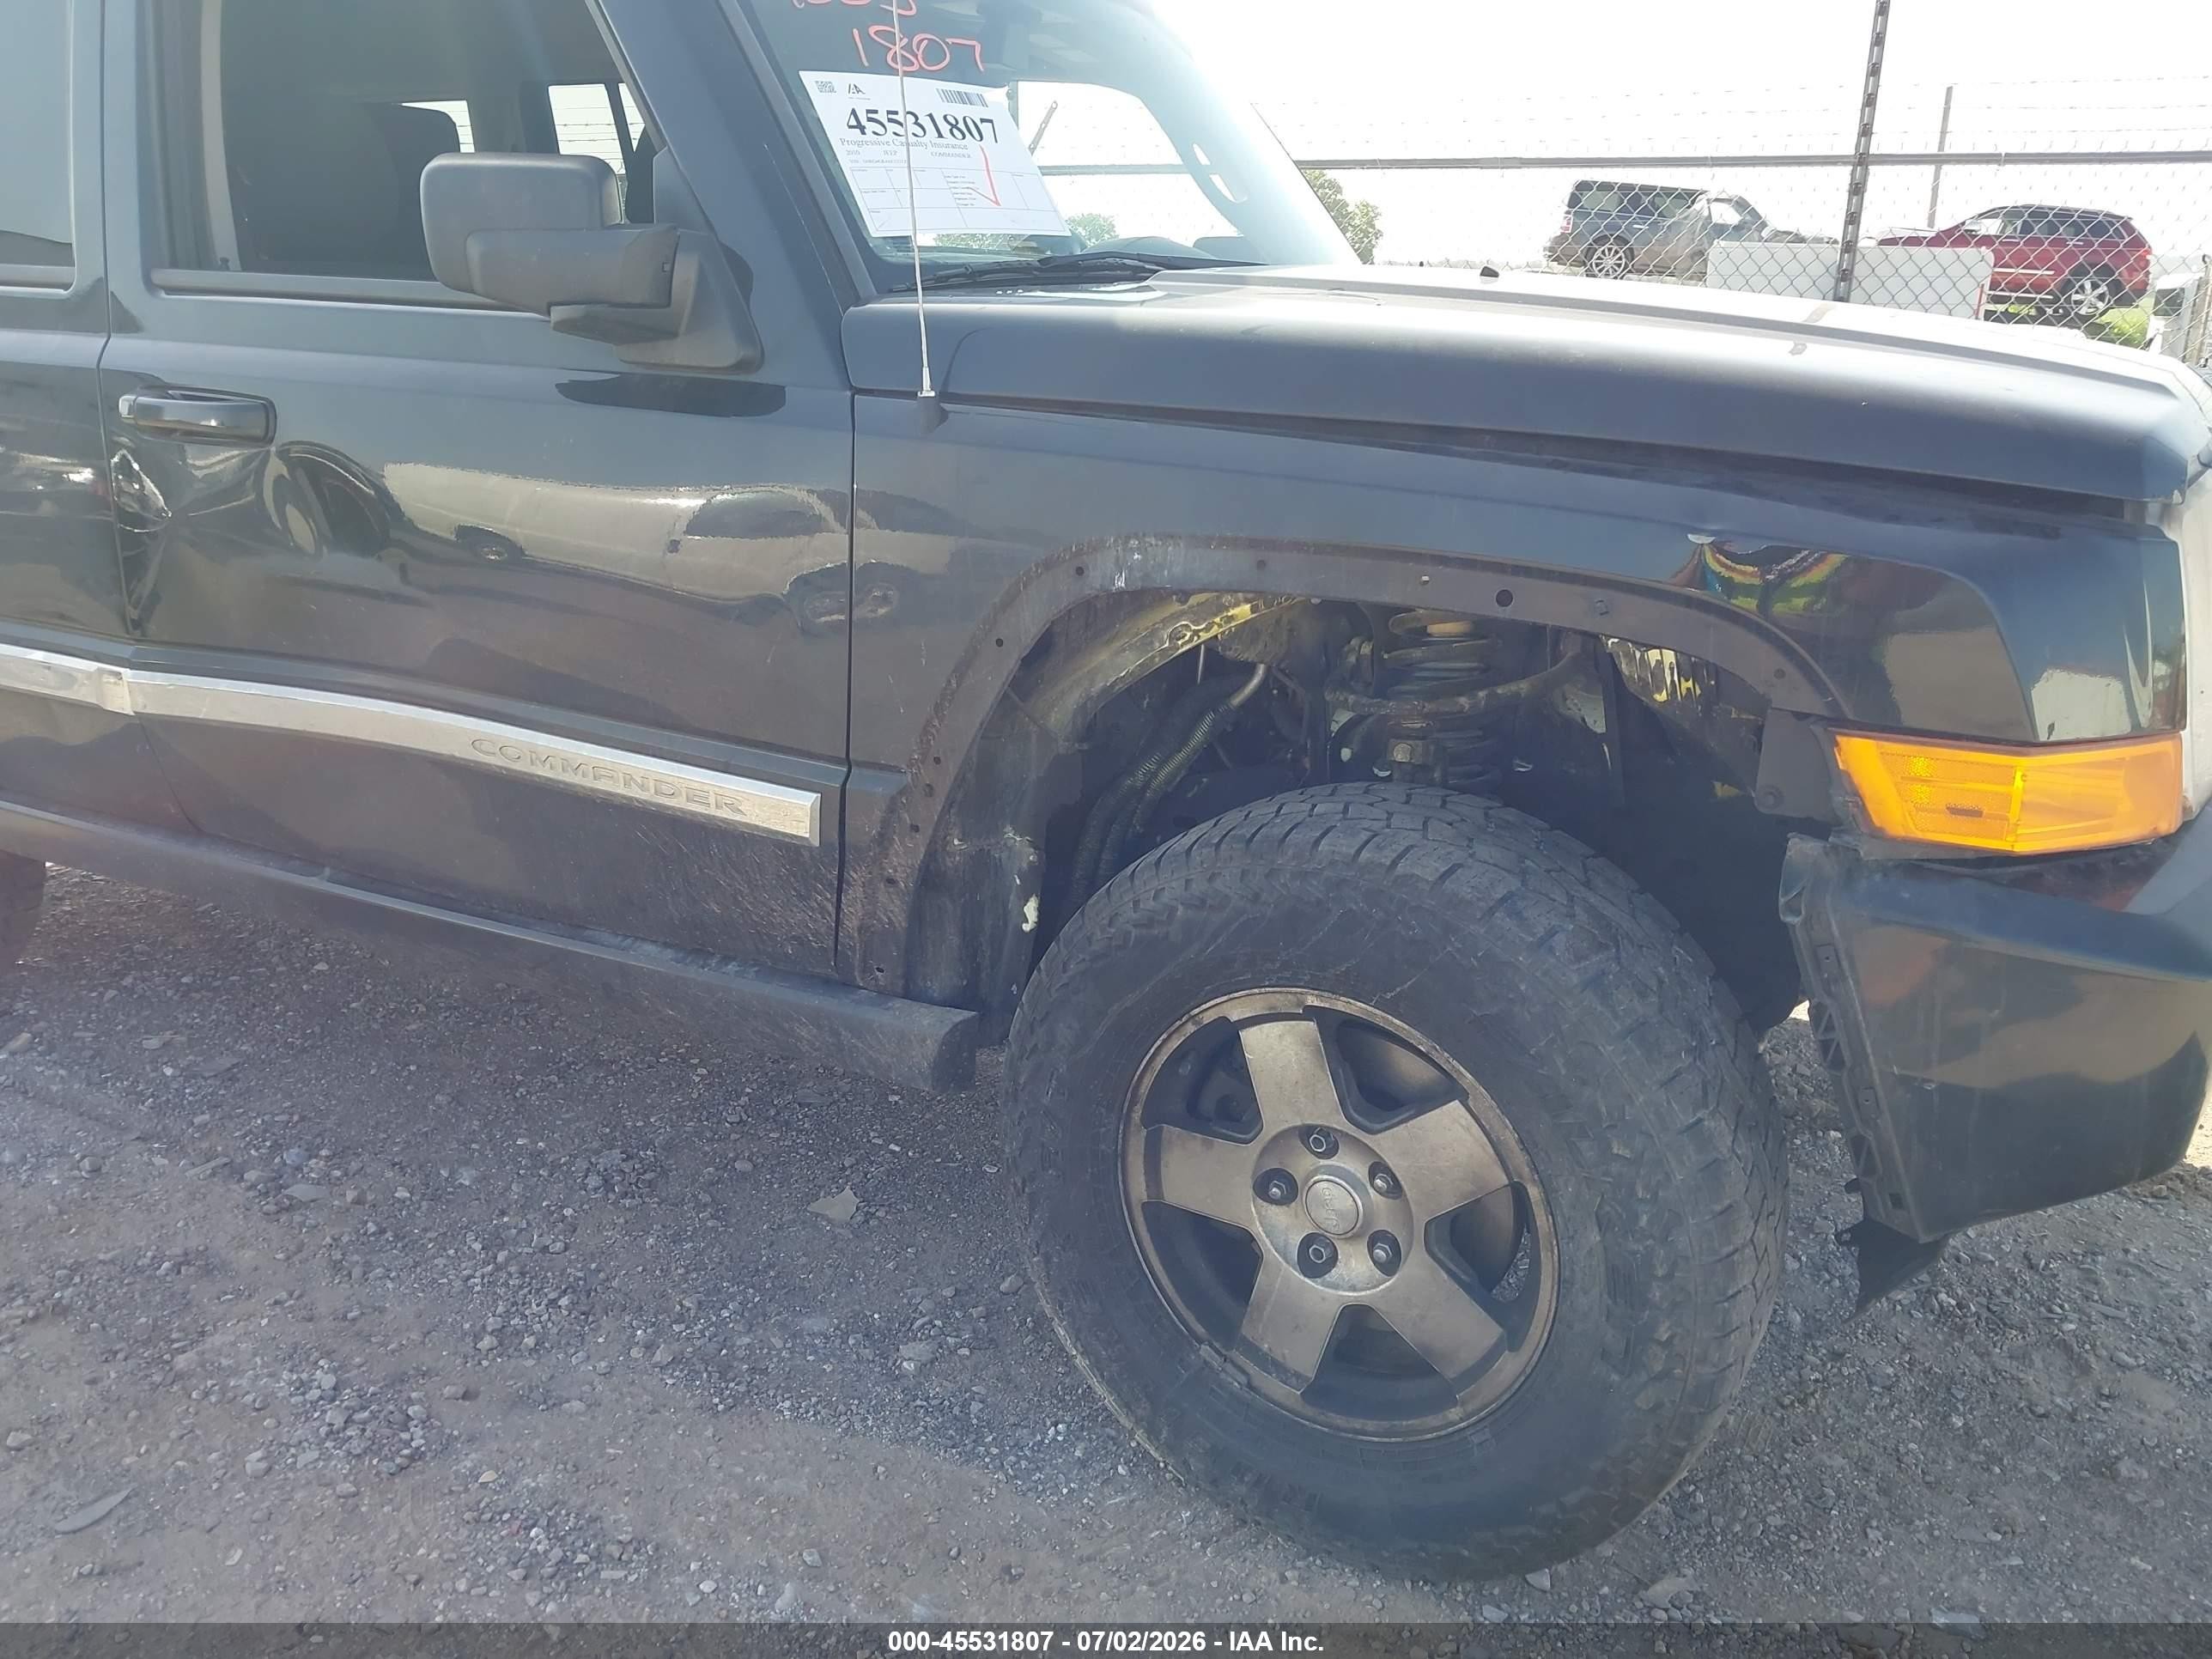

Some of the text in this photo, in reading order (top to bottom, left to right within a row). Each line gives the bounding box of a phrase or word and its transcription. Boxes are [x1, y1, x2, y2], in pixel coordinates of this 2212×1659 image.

[852, 25, 985, 73] 1807
[840, 137, 890, 149] Progressive
[930, 140, 969, 150] Insurance
[846, 108, 999, 144] 45531807
[471, 738, 747, 816] COMMANDER
